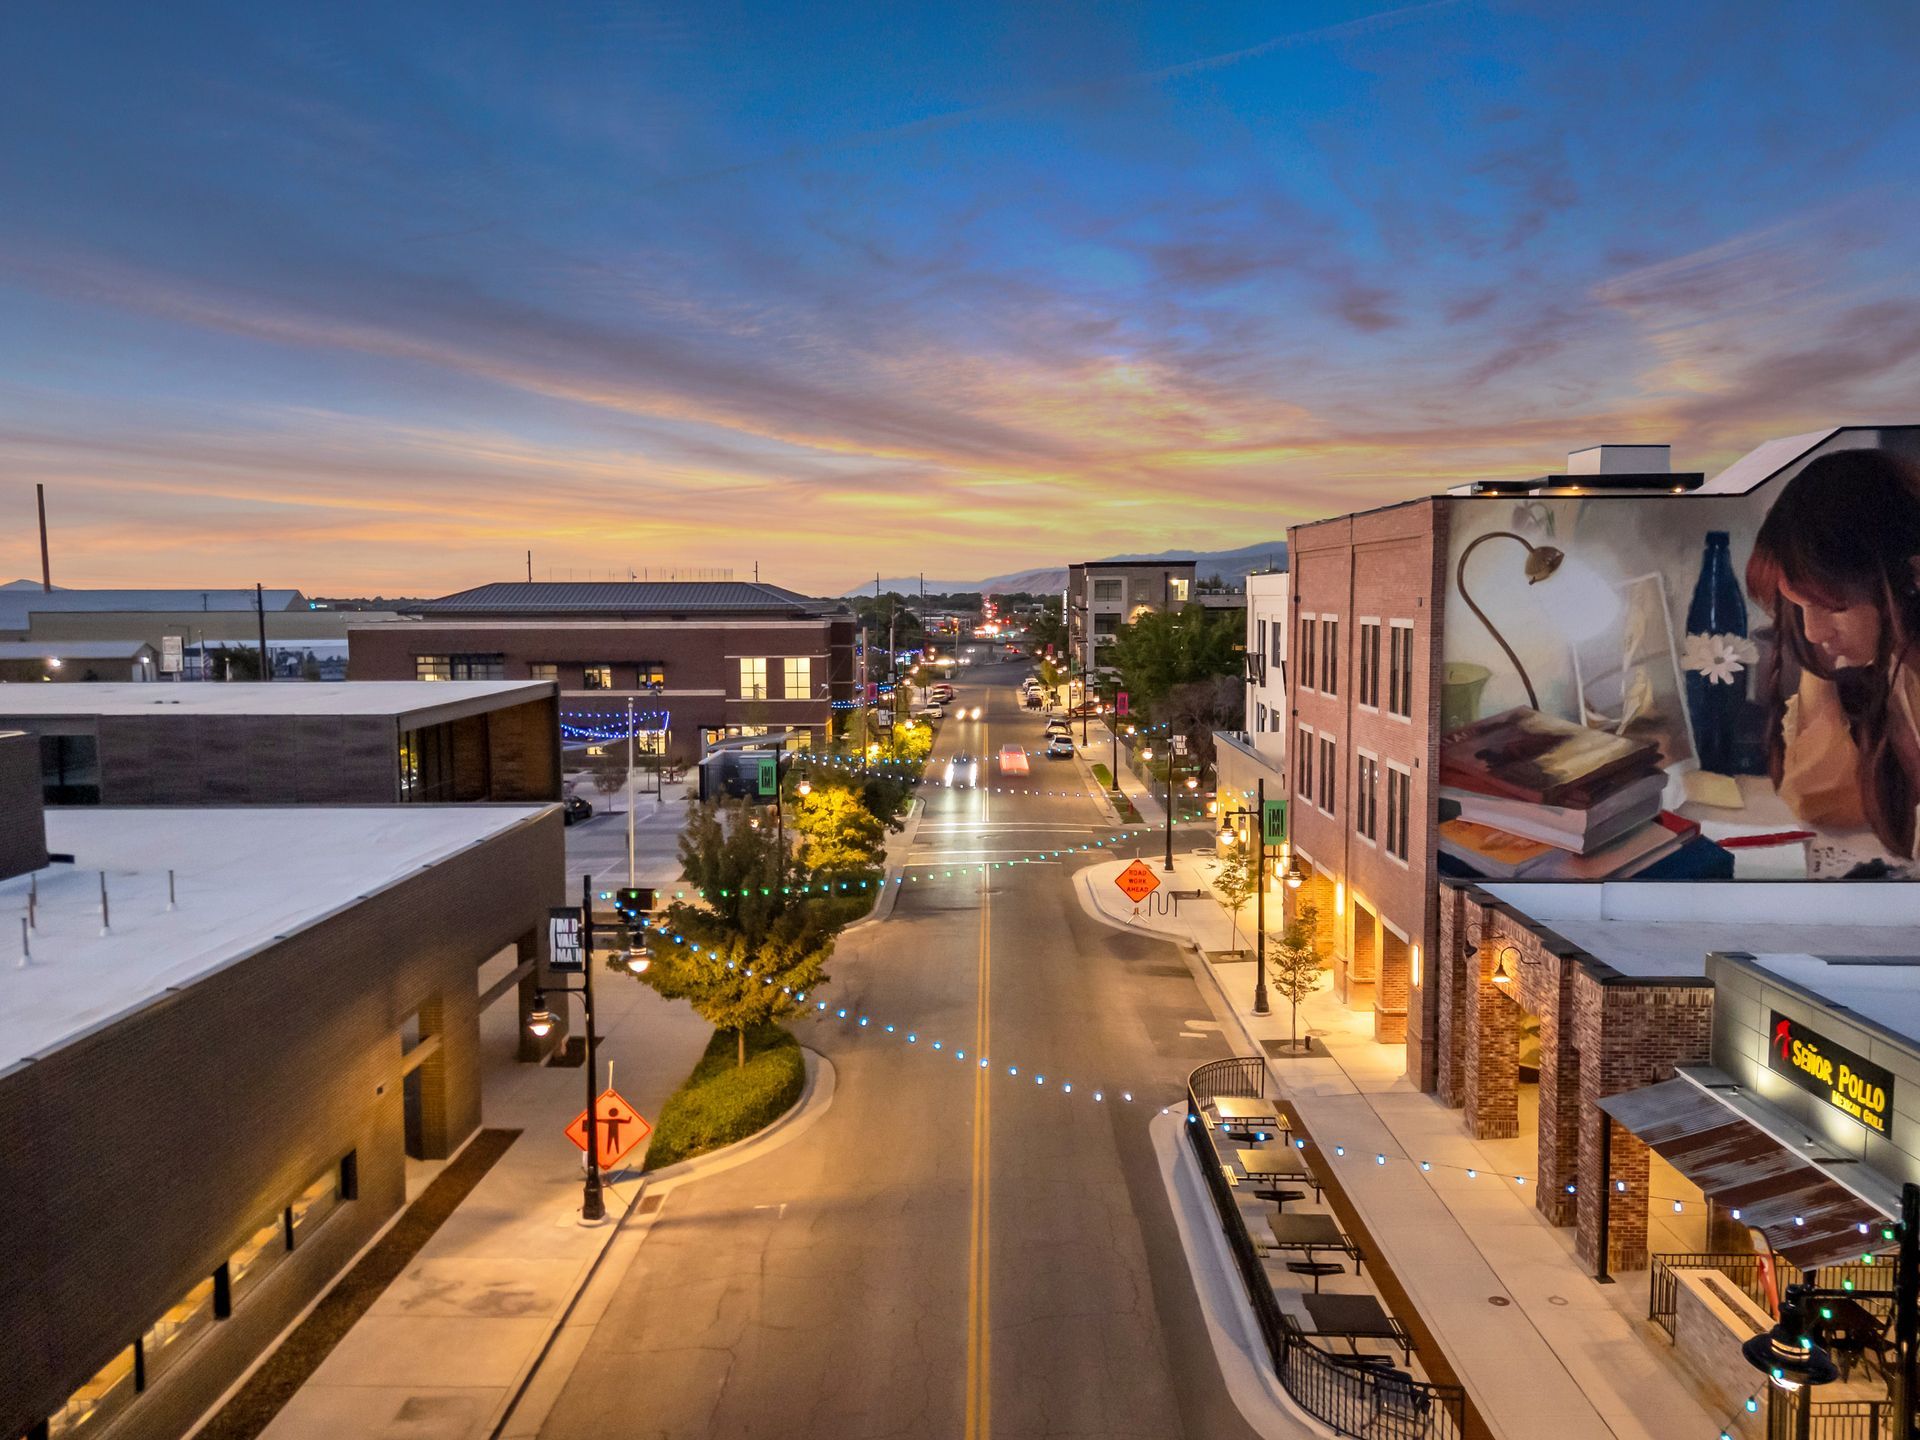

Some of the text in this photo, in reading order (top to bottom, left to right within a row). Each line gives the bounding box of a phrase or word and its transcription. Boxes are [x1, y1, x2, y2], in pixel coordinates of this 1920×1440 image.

[1792, 1040, 1885, 1113] SEÑOR POLLO
[1831, 1089, 1885, 1132] MEXICAN GRILL
